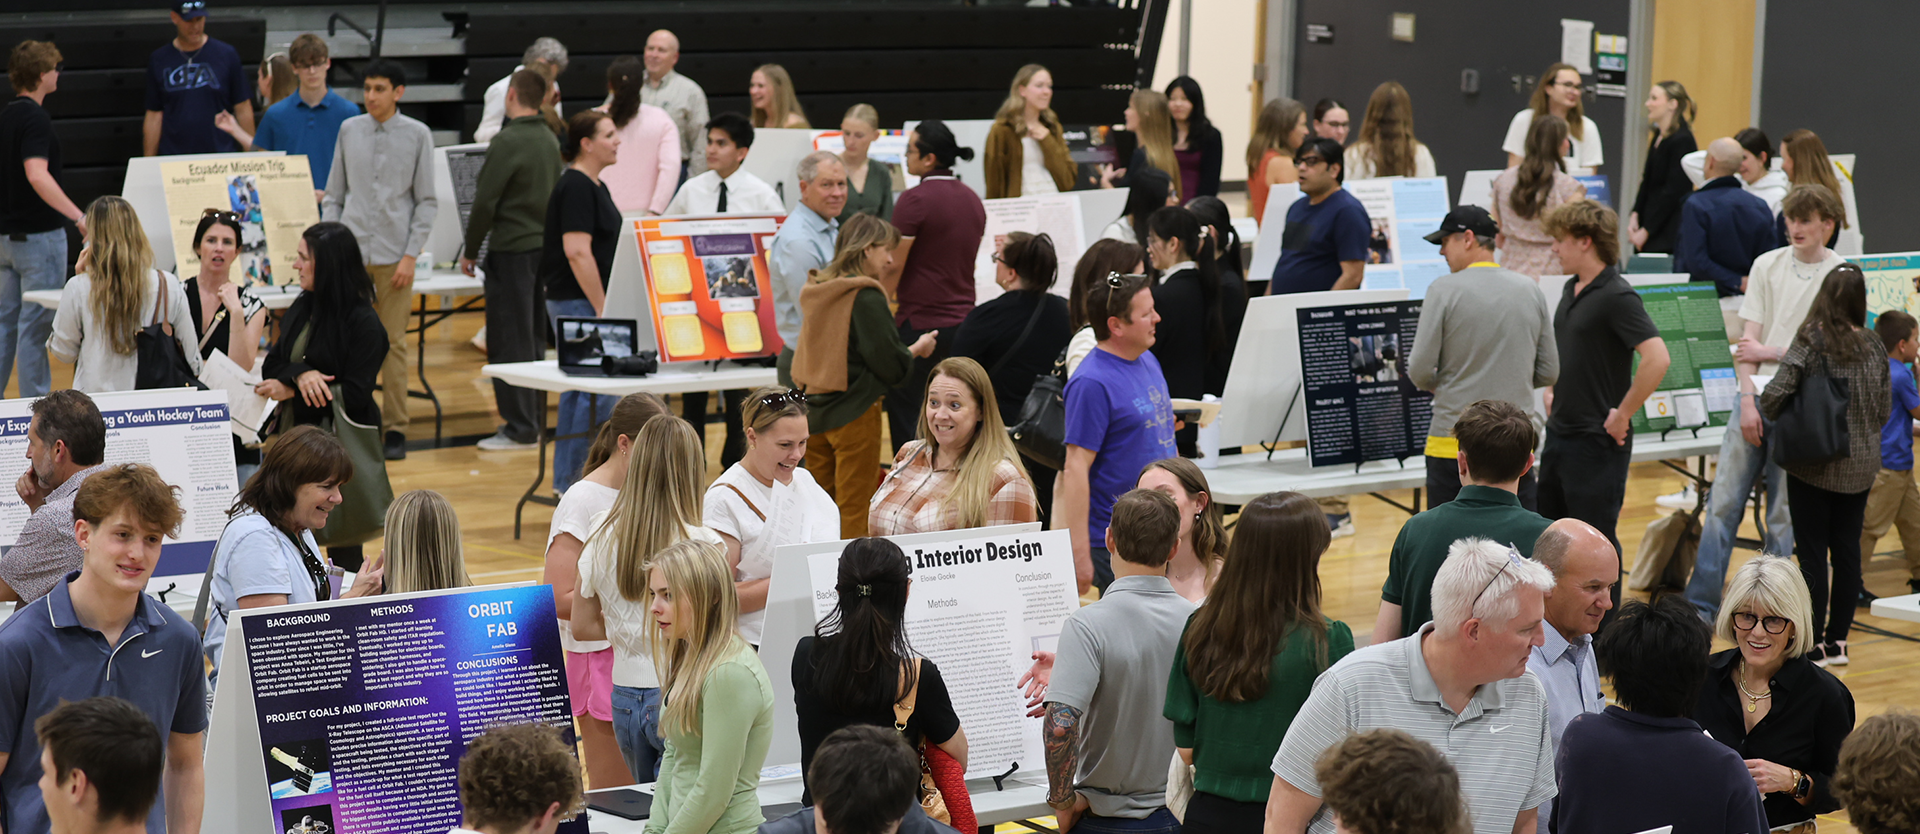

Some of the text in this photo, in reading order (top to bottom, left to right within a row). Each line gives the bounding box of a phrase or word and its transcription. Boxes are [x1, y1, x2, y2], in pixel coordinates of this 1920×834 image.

[188, 159, 286, 176] Ecuador Mission Trip
[172, 176, 206, 185] Background
[117, 415, 124, 423] a
[125, 410, 155, 423] Youth
[157, 409, 194, 422] Hockey
[195, 407, 223, 419] Team
[915, 545, 982, 569] Interior
[985, 539, 1043, 562] Design
[920, 572, 956, 583] Eloise Gocke
[1015, 571, 1052, 583] Conclusion
[816, 589, 837, 600] Backg
[370, 604, 414, 616] METHODS
[468, 600, 513, 618] ORBIT
[927, 597, 958, 609] Methods
[266, 613, 331, 628] BACKGROUND
[486, 621, 518, 638] FAB
[456, 655, 518, 670] CONCLUSIONS
[266, 696, 429, 724] PROJECT GOALS AND INFORMATION:
